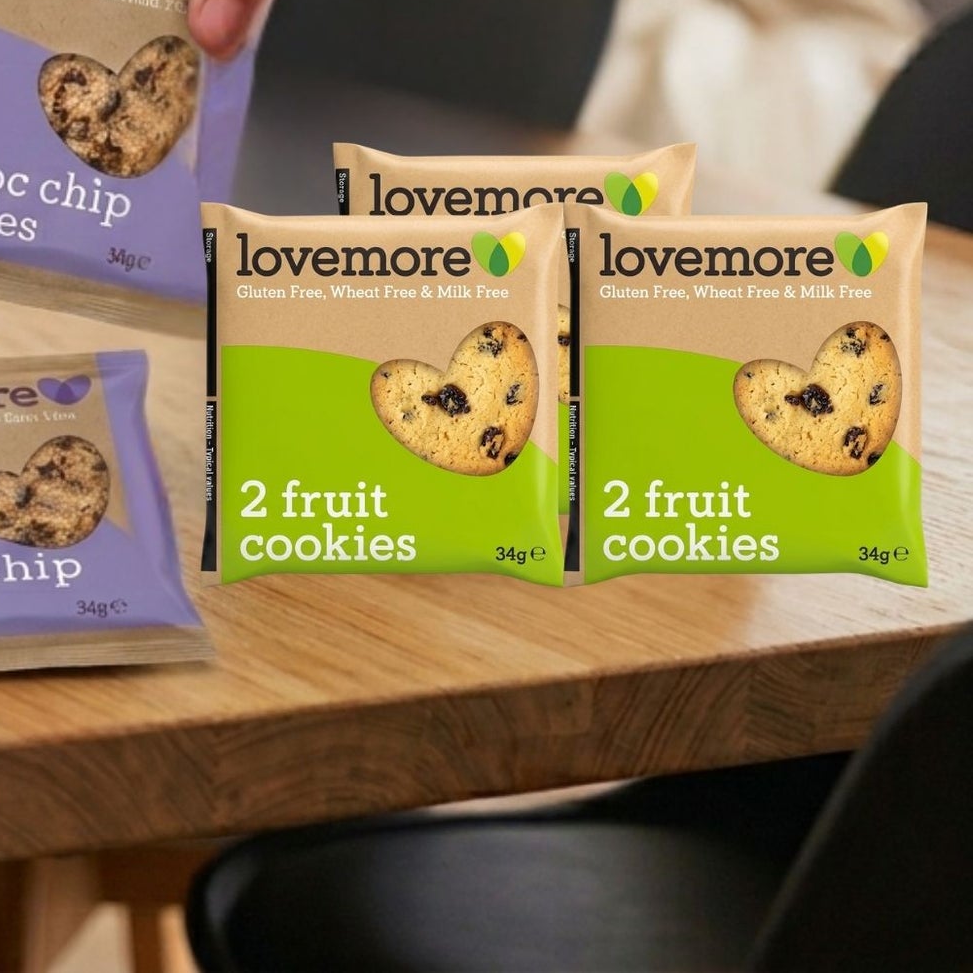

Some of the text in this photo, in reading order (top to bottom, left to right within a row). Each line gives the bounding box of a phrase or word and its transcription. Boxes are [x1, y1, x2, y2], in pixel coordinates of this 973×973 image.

[38, 171, 132, 228] chip
[236, 233, 471, 277] lovemore
[599, 233, 835, 277] lovemore
[236, 284, 509, 301] Gluten Free, Wheat Free & Milk Free
[599, 284, 872, 301] Gluten Free, Wheat Free & Milk Free
[240, 480, 388, 518] 2 fruit
[603, 480, 751, 518] 2 fruit
[240, 523, 417, 562] cookies
[495, 546, 526, 564] 34g
[603, 523, 780, 562] cookies
[858, 546, 890, 564] 34g
[76, 599, 108, 618] 34g
